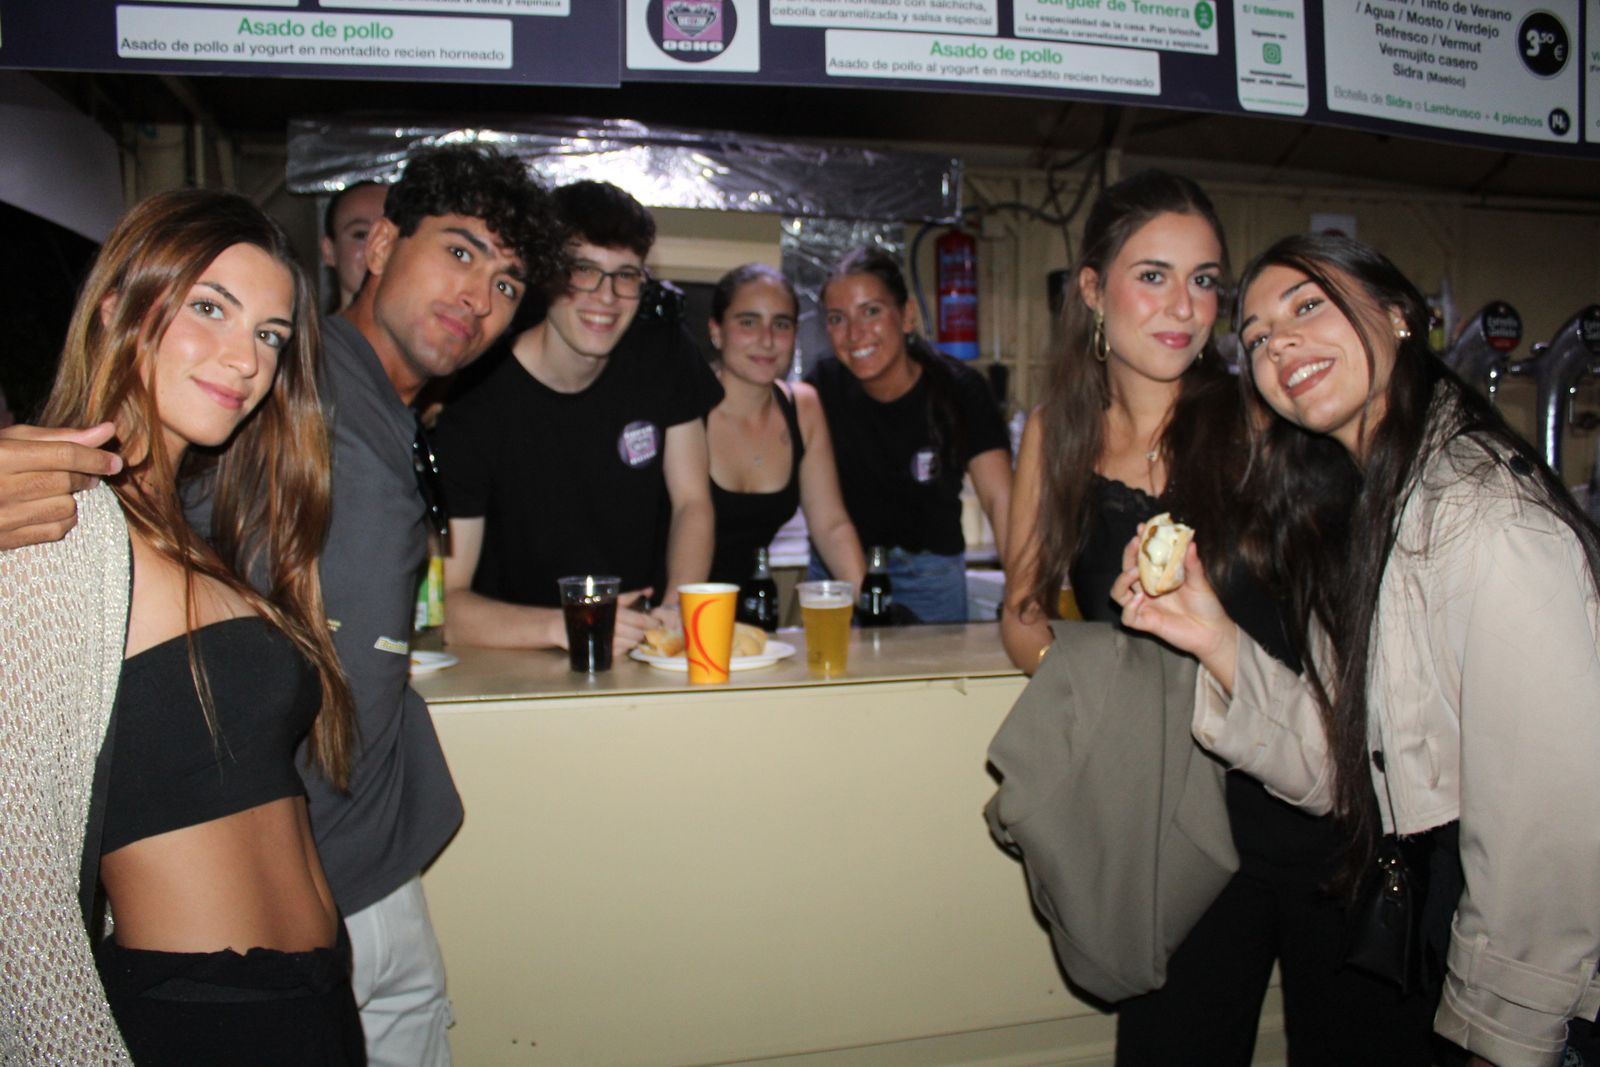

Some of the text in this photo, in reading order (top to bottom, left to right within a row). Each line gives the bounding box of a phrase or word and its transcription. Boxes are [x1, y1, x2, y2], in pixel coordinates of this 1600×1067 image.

[930, 0, 986, 12] salchicha,
[1107, 0, 1126, 12] de
[1131, 0, 1189, 19] Ternera
[1453, 2, 1467, 15] de
[1470, 4, 1512, 21] Verano
[238, 17, 394, 42] Asado de pollo
[901, 13, 907, 23] y
[944, 15, 993, 25] especial
[1364, 3, 1395, 20] Agua
[1407, 10, 1443, 29] Mosto
[1454, 19, 1499, 39] Verdejo
[120, 38, 504, 61] Asado de pollo al yogurt en montadito recien horneado
[1376, 23, 1428, 45] Refresco
[1440, 35, 1481, 53] Vermut
[930, 40, 1063, 65] Asado de pollo
[1379, 41, 1478, 71] Vermujito casero
[829, 58, 1154, 88] Asado de pollo al yogurt en montadito recien horneado
[1393, 63, 1423, 80] Sidra
[1386, 94, 1412, 110] Sidra
[1424, 101, 1482, 120] Lambrusco
[1493, 111, 1500, 121] 4
[1502, 113, 1543, 127] pinchos
